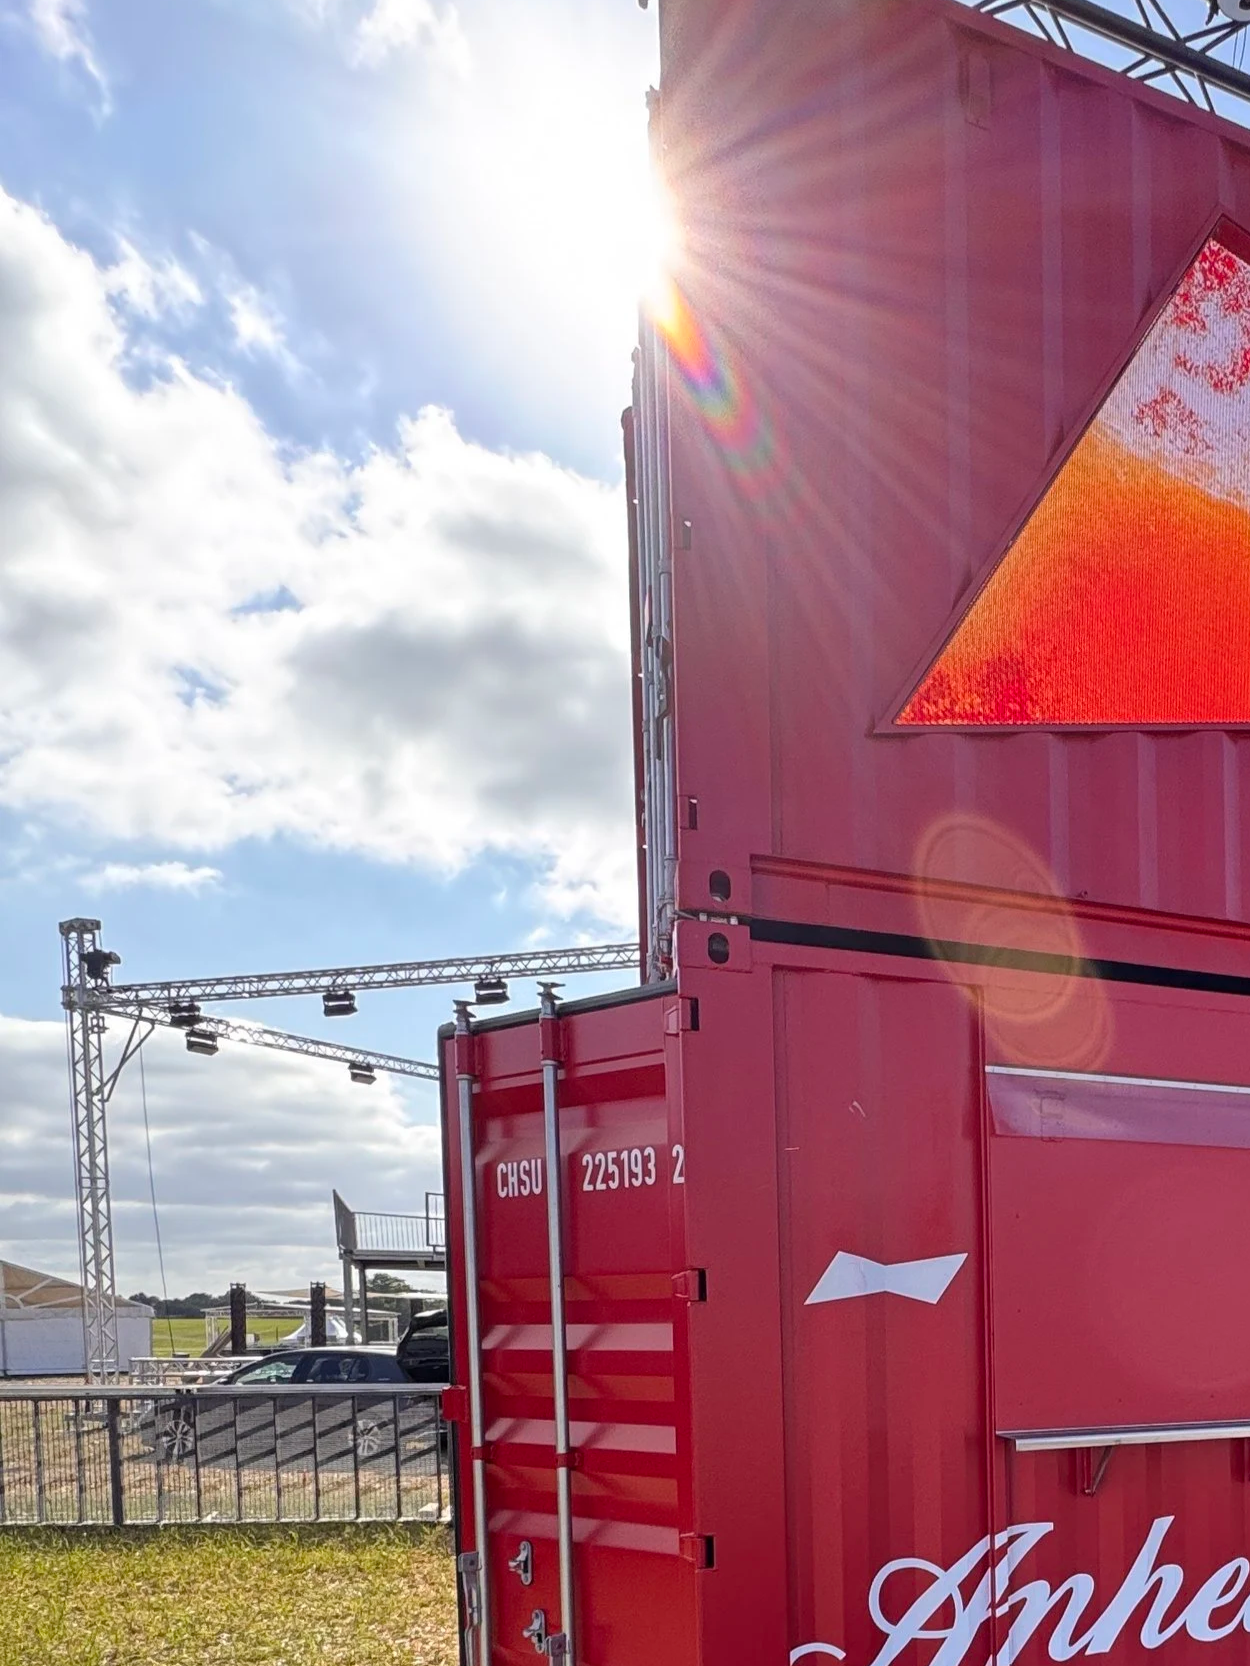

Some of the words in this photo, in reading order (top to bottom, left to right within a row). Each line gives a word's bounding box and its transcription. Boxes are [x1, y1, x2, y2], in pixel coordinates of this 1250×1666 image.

[497, 1158, 542, 1198] CHSU
[582, 1146, 656, 1192] 225193
[672, 1144, 685, 1184] 2
